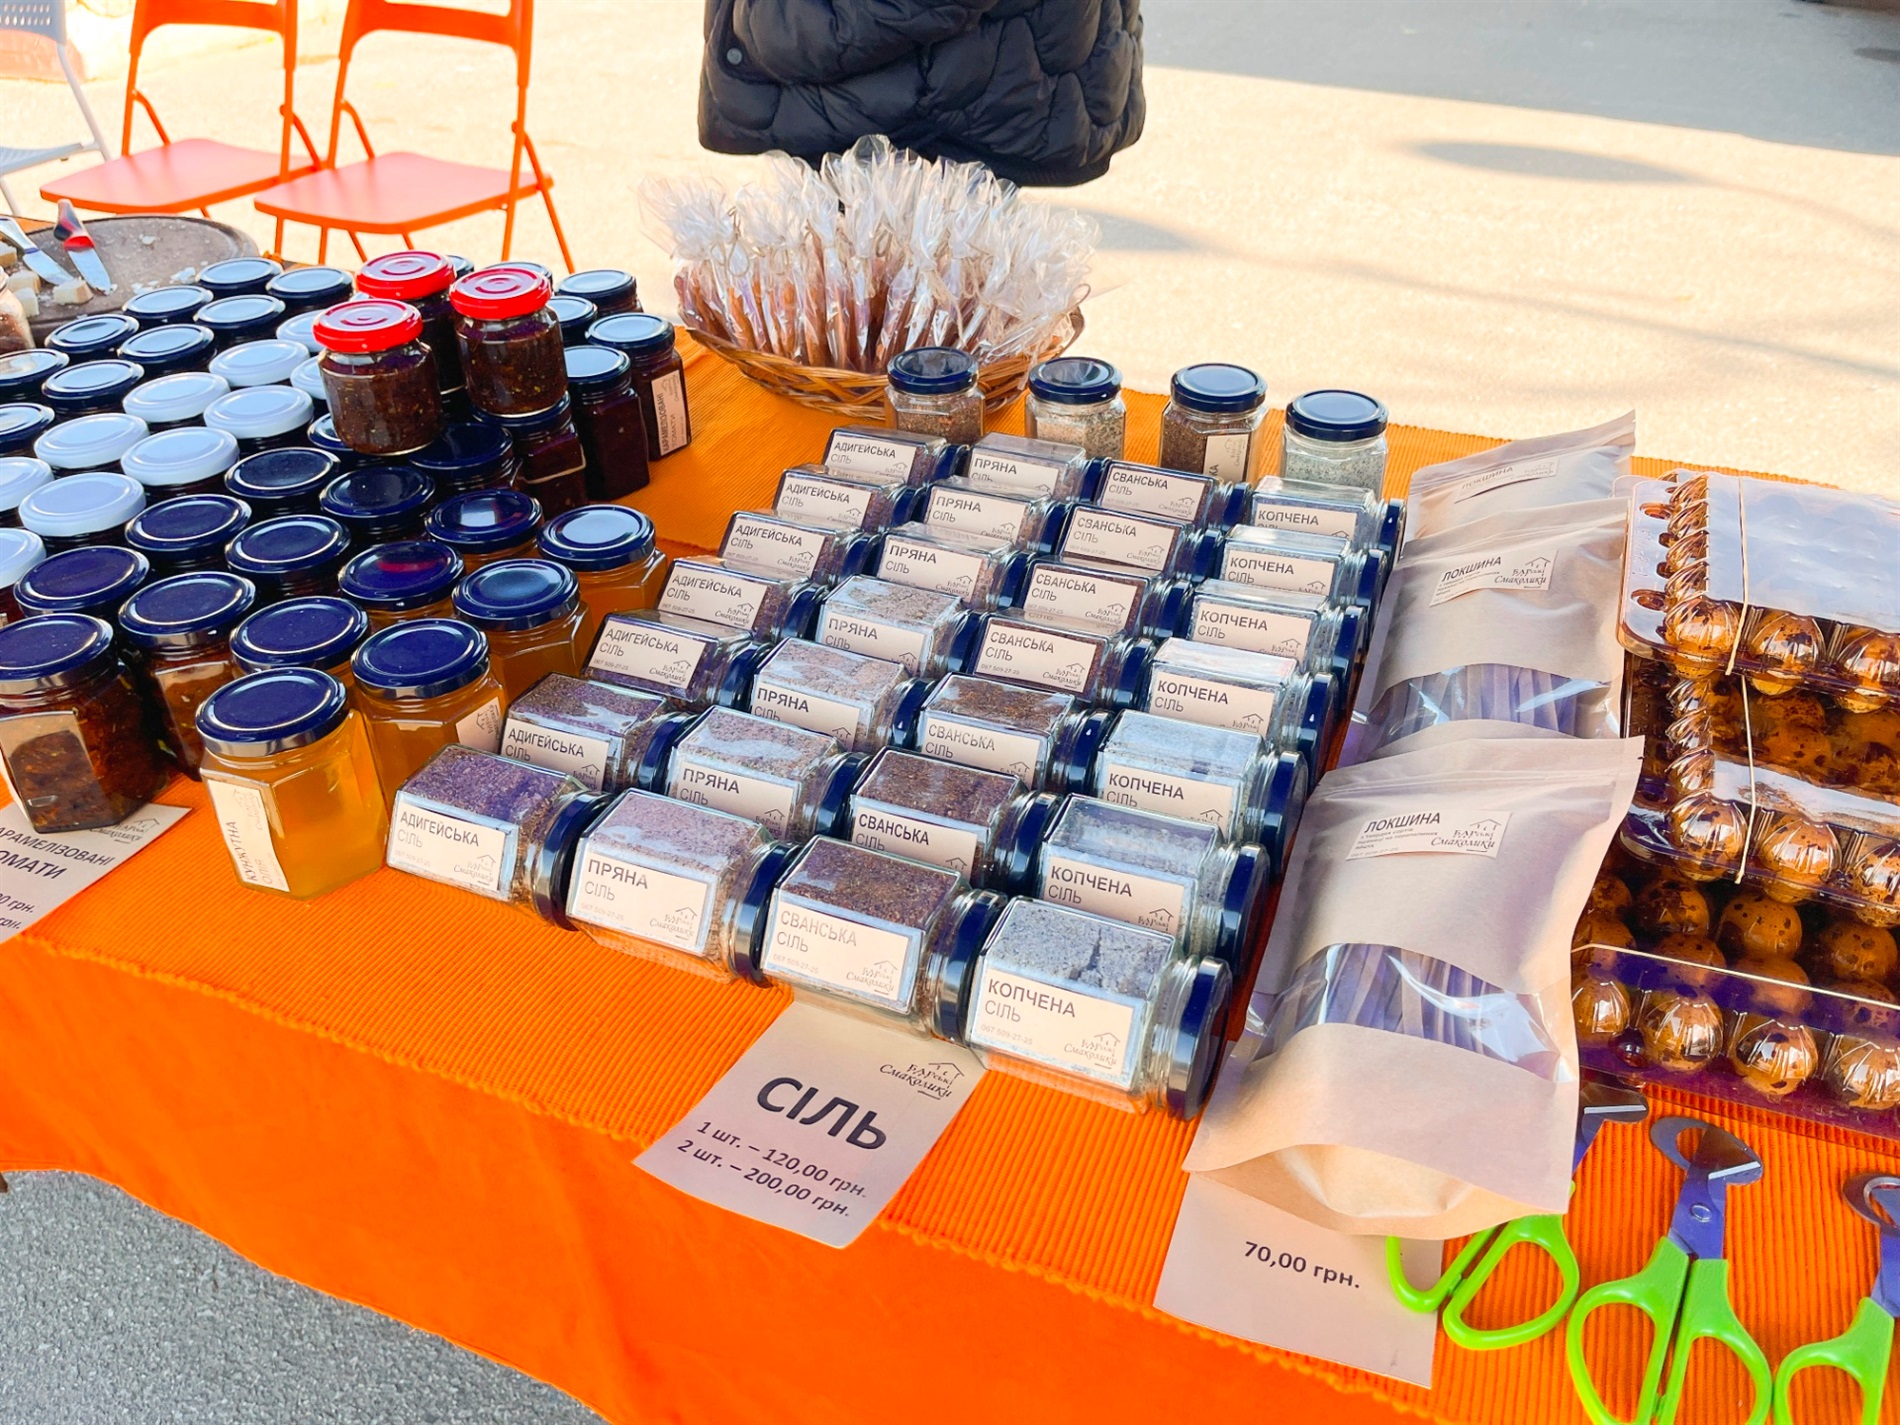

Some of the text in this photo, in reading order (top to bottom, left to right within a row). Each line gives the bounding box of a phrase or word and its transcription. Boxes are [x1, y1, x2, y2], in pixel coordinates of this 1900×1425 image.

[831, 453, 852, 465] СІЛЬ
[834, 441, 896, 458] АДИГЕЙСЬКА
[974, 457, 1017, 475] ПРЯНА
[1109, 484, 1133, 496] СІЛЬ
[1112, 472, 1168, 489] СВАНСЬКА
[781, 496, 804, 508] СІЛЬ
[785, 483, 850, 505] АДИГЕЙСЬКА
[936, 496, 982, 513] ПРЯНА
[932, 510, 956, 523] СІЛЬ
[1077, 517, 1137, 537] СВАНСЬКА
[1258, 510, 1319, 526] КОПЧЕНА
[730, 537, 754, 549] СІЛЬ
[735, 524, 802, 547] АДИГЕЙСЬКА
[1073, 531, 1099, 544] СІЛЬ
[889, 545, 937, 564] ПРЯНА
[885, 561, 910, 574] СІЛЬ
[1230, 557, 1294, 575] КОПЧЕНА
[1442, 556, 1502, 583] ЛОКШИНА
[672, 574, 742, 598] АДИГЕЙСЬКА
[1036, 573, 1097, 594] СВАНСЬКА
[667, 588, 691, 601] СІЛЬ
[1031, 588, 1057, 602] СІЛЬ
[828, 618, 878, 640] ПРЯНА
[1200, 610, 1268, 631] КОПЧЕНА
[605, 628, 679, 654] АДИГЕЙСЬКА
[825, 635, 850, 649] СІЛЬ
[990, 631, 1055, 654] СВАНСЬКА
[1197, 625, 1226, 639] СІЛЬ
[599, 642, 625, 657] СІЛЬ
[985, 646, 1013, 662] СІЛЬ
[757, 687, 810, 713] ПРЯНА
[1157, 680, 1229, 705] КОПЧЕНА
[1155, 696, 1184, 713] СІЛЬ
[508, 728, 584, 758] АДИГЕЙСЬКА
[928, 724, 995, 751] СВАНСЬКА
[505, 745, 531, 762] СІЛЬ
[925, 741, 954, 759] СІЛЬ
[683, 768, 740, 794] ПРЯНА
[1109, 773, 1184, 800] КОПЧЕНА
[680, 788, 709, 806] СІЛЬ
[1107, 791, 1138, 808] СІЛЬ
[400, 811, 479, 847] АДИГЕЙСЬКА
[859, 813, 929, 846] СВАНСЬКА
[1364, 812, 1441, 833] ЛОКШИНА
[397, 829, 423, 848] СІЛЬ
[856, 833, 885, 851] СІЛЬ
[588, 859, 648, 889] ПРЯНА
[1051, 865, 1132, 897] КОПЧЕНА
[585, 881, 615, 901] СІЛЬ
[1048, 884, 1082, 905] СІЛЬ
[780, 910, 857, 947] СВАНСЬКА
[777, 931, 809, 953] СІЛЬ
[988, 978, 1076, 1018] КОПЧЕНА
[984, 1000, 1021, 1023] СІЛЬ
[879, 1064, 952, 1099] Смаколики
[757, 1077, 887, 1150] СІЛЬ
[697, 1121, 712, 1134] 1
[712, 1128, 742, 1149] шт.
[762, 1147, 829, 1182] 120,00
[829, 1176, 868, 1199] грн.
[677, 1139, 695, 1154] 2
[692, 1147, 723, 1169] шт.
[743, 1167, 811, 1202] 200,00
[811, 1195, 850, 1217] грн.
[1244, 1241, 1360, 1289] 70,00 грн.
